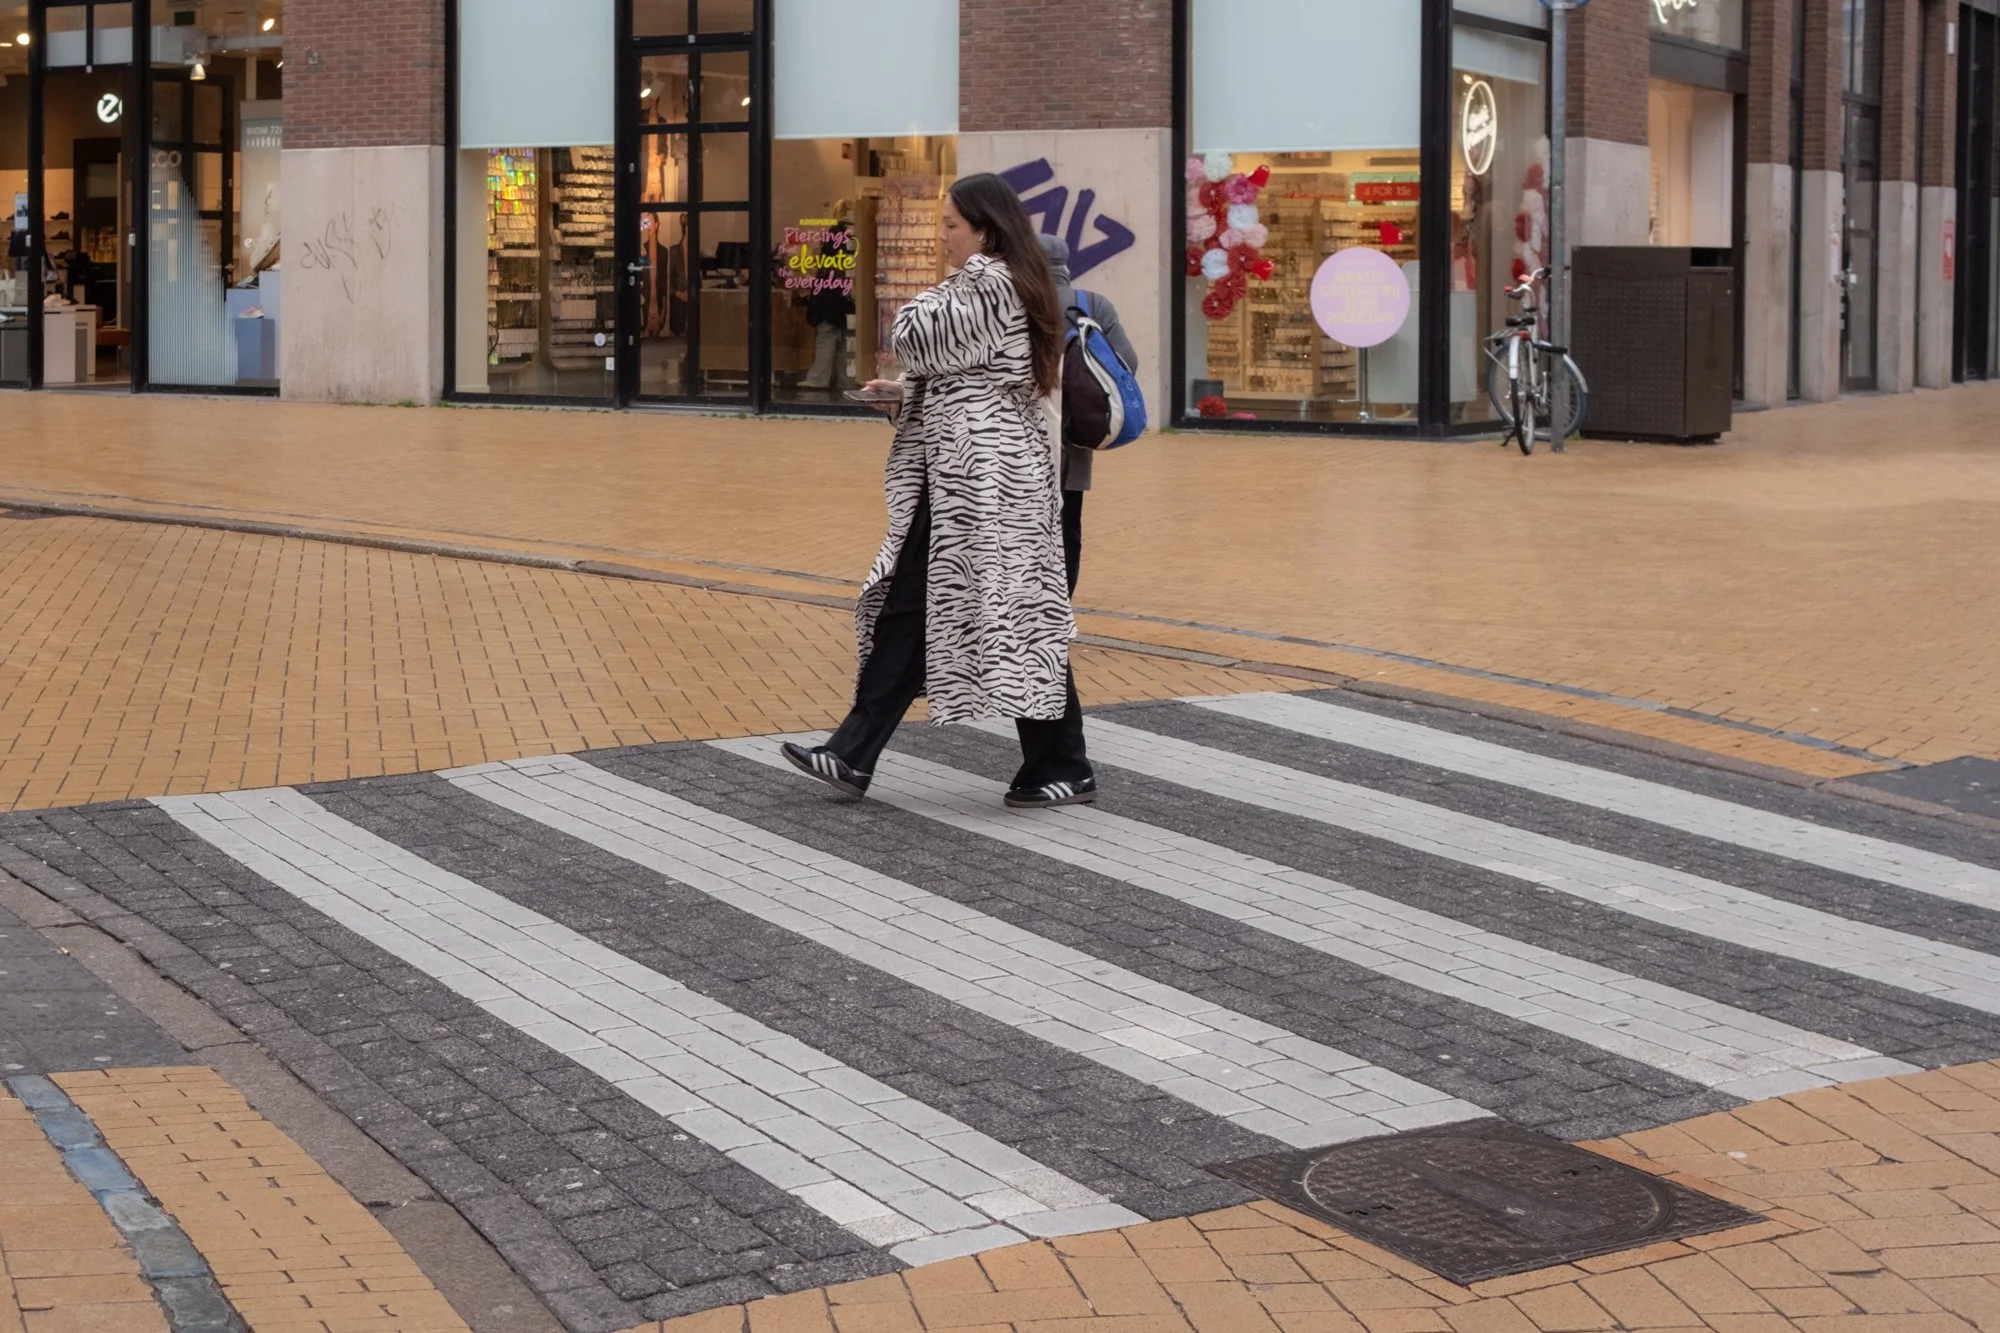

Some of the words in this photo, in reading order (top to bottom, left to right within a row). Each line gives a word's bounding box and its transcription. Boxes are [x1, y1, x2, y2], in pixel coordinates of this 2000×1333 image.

[784, 226, 855, 249] Piercings
[789, 243, 857, 274] elevate
[778, 266, 794, 277] the
[784, 270, 853, 296] everyday
